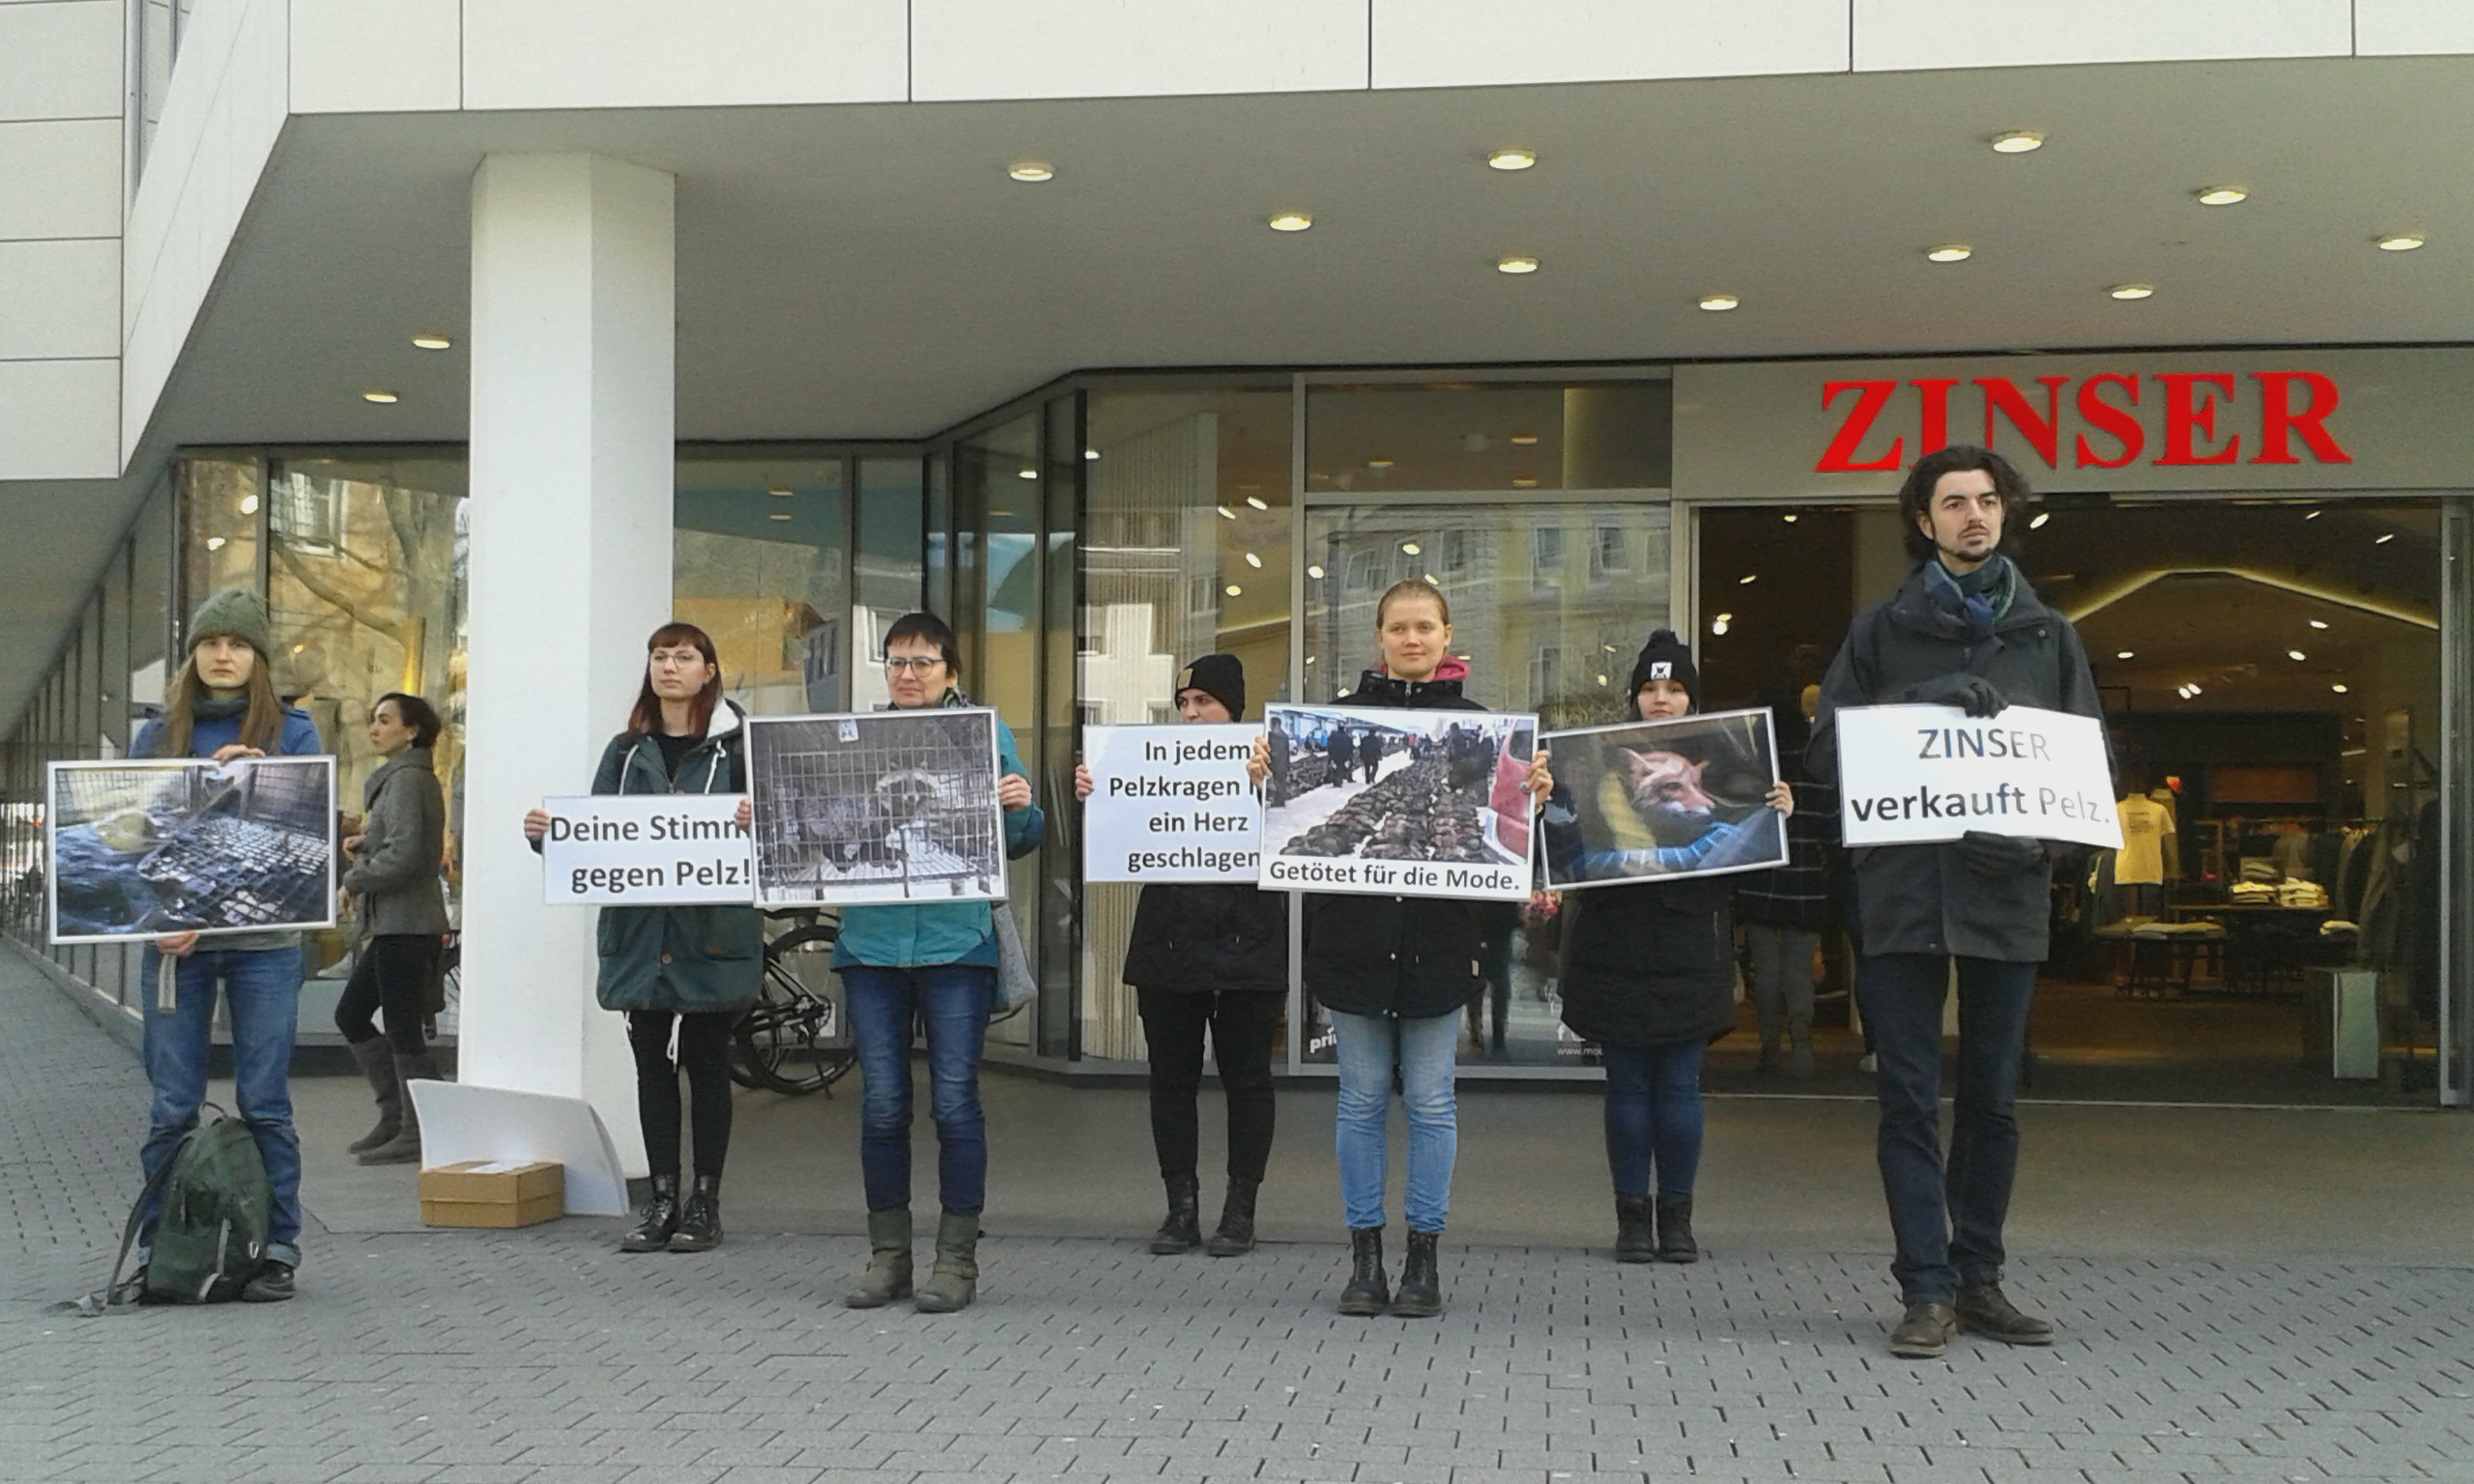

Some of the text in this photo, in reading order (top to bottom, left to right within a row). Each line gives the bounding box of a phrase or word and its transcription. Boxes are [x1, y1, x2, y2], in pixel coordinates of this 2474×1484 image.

[1814, 371, 2353, 471] ZINSER
[1145, 739, 1251, 766] In jedem
[1917, 728, 2051, 761] ZINSER
[1109, 775, 1240, 801] Pelzkragen
[1851, 783, 2028, 822] verkauft
[2038, 786, 2111, 824] Pelz.
[551, 814, 639, 842] Deine
[1149, 812, 1249, 833] ein Herz
[1128, 846, 1259, 873] geschlagen
[571, 858, 751, 894] gegen Pelz!
[1270, 861, 1520, 891] Getötet für die Mode.
